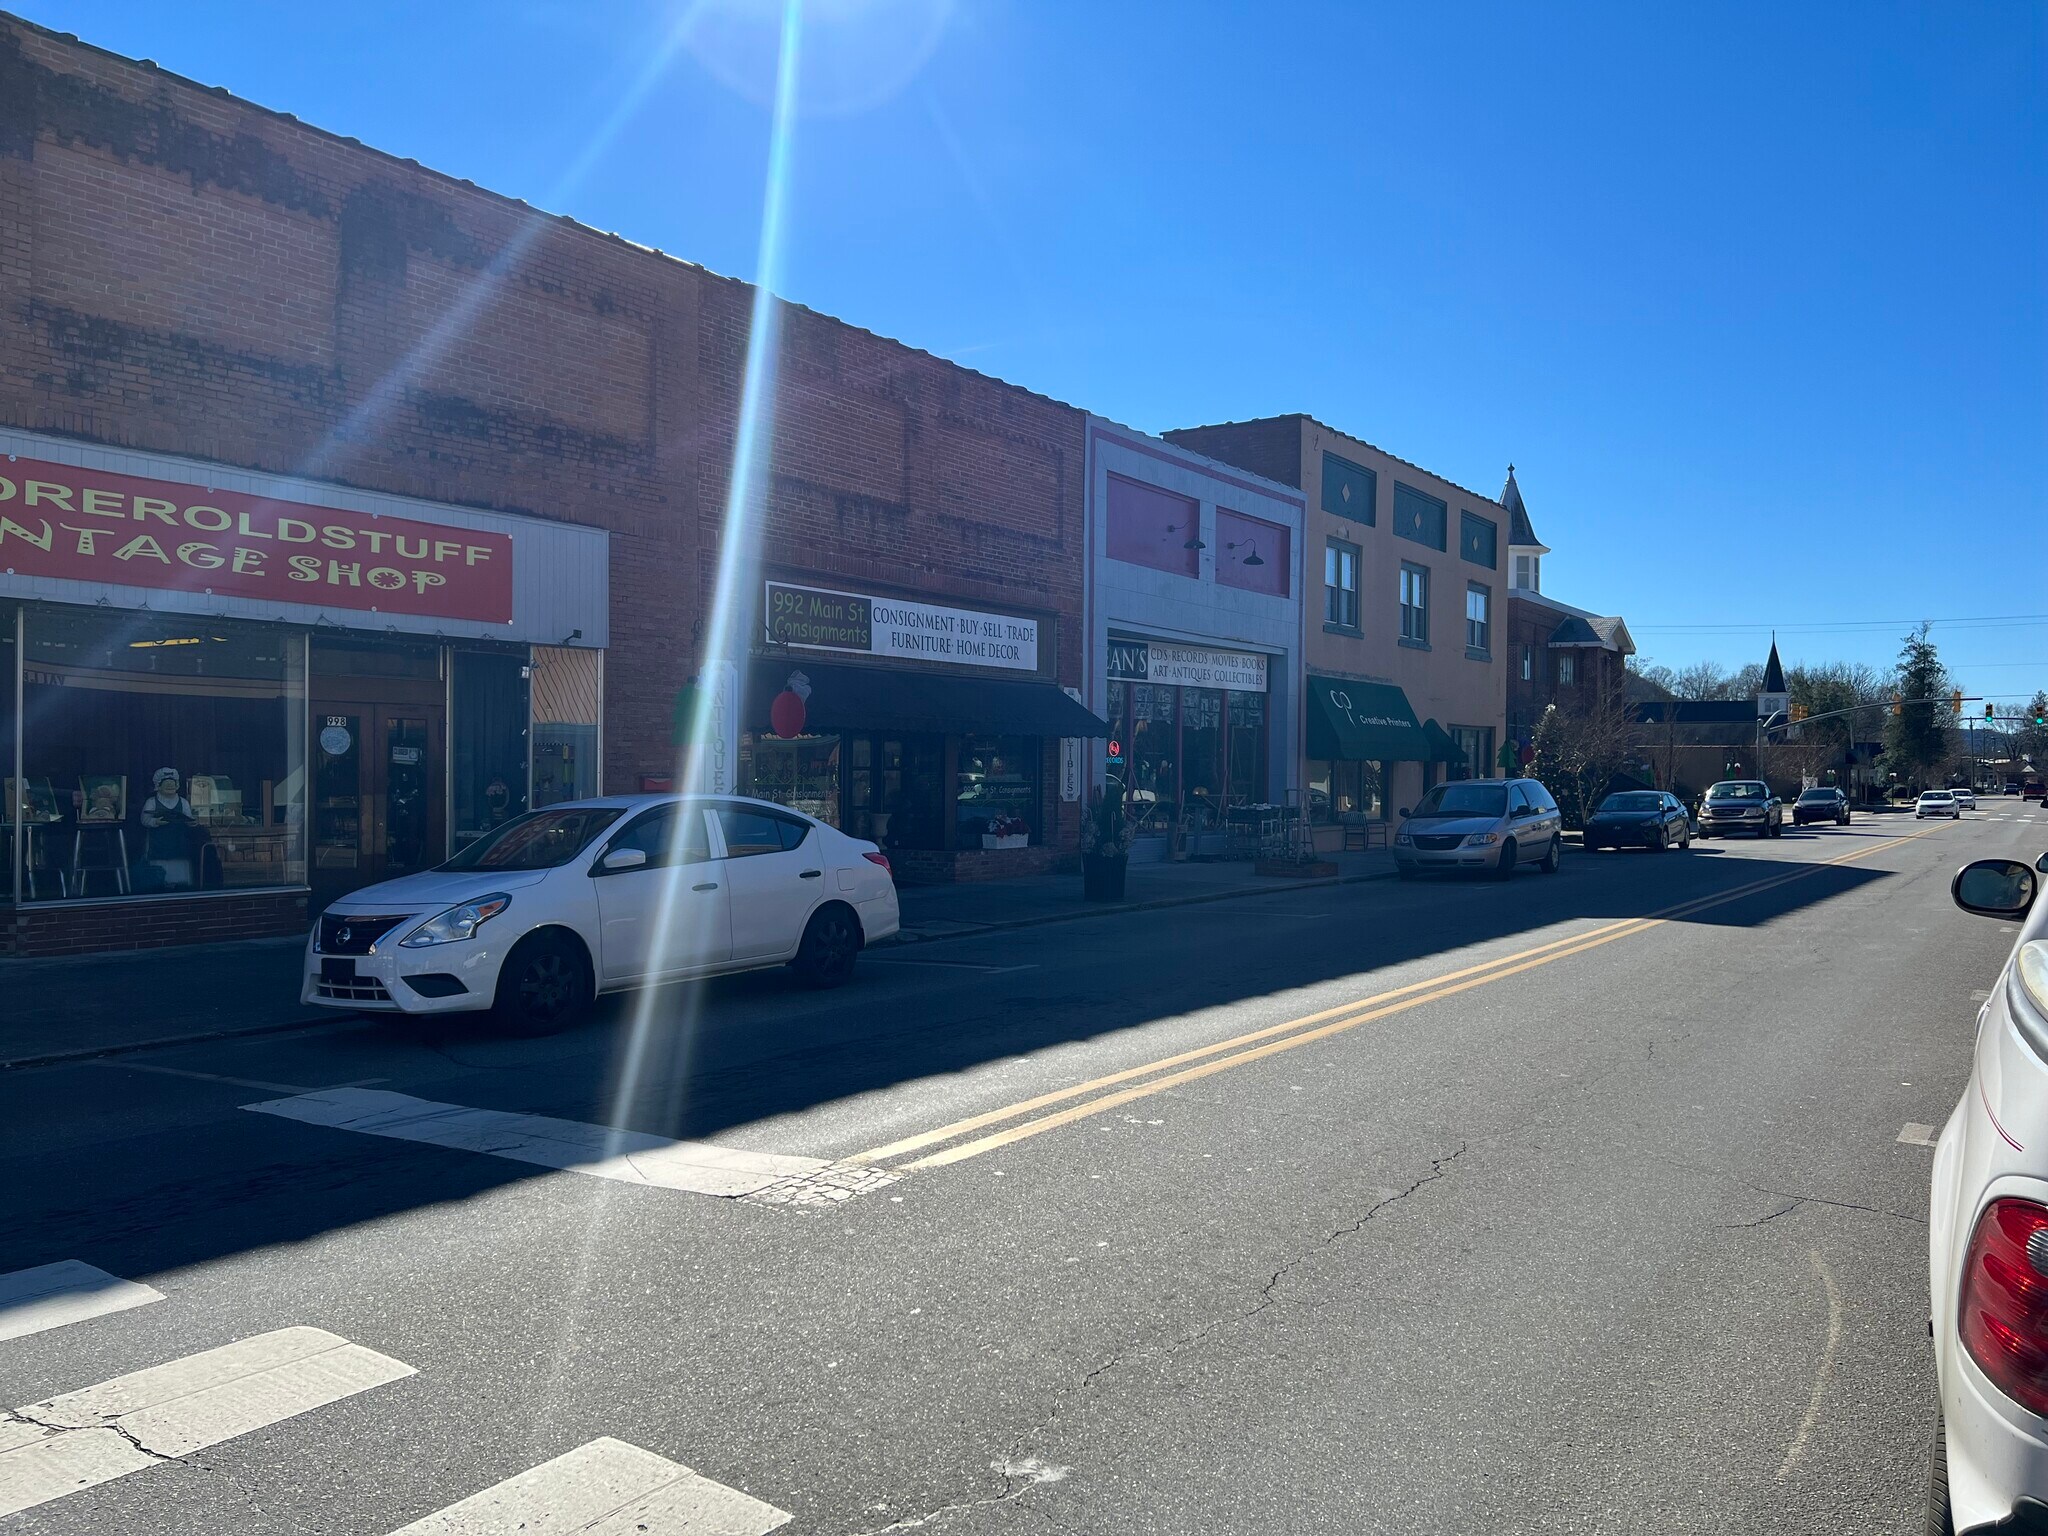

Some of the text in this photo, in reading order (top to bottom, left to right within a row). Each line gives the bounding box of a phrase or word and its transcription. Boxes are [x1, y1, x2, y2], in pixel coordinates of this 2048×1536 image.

[288, 555, 447, 595] SHOP
[774, 591, 867, 623] 992 Main St.
[774, 615, 868, 644] Consignments
[873, 607, 1034, 642] CONSIGNMENT BUY SELL TRADE
[891, 631, 1020, 660] FURNITURE HOME DECOR
[1107, 647, 1147, 673] AN'S
[1172, 650, 1208, 664] RECORDS
[1211, 654, 1239, 668] MOVIES
[1241, 657, 1265, 671] BOOKS
[1153, 665, 1263, 685] ART ANTIQUES COLLECTIBLES
[328, 717, 346, 726] 998
[1359, 714, 1412, 728] Creative Printers
[751, 788, 770, 799] Main
